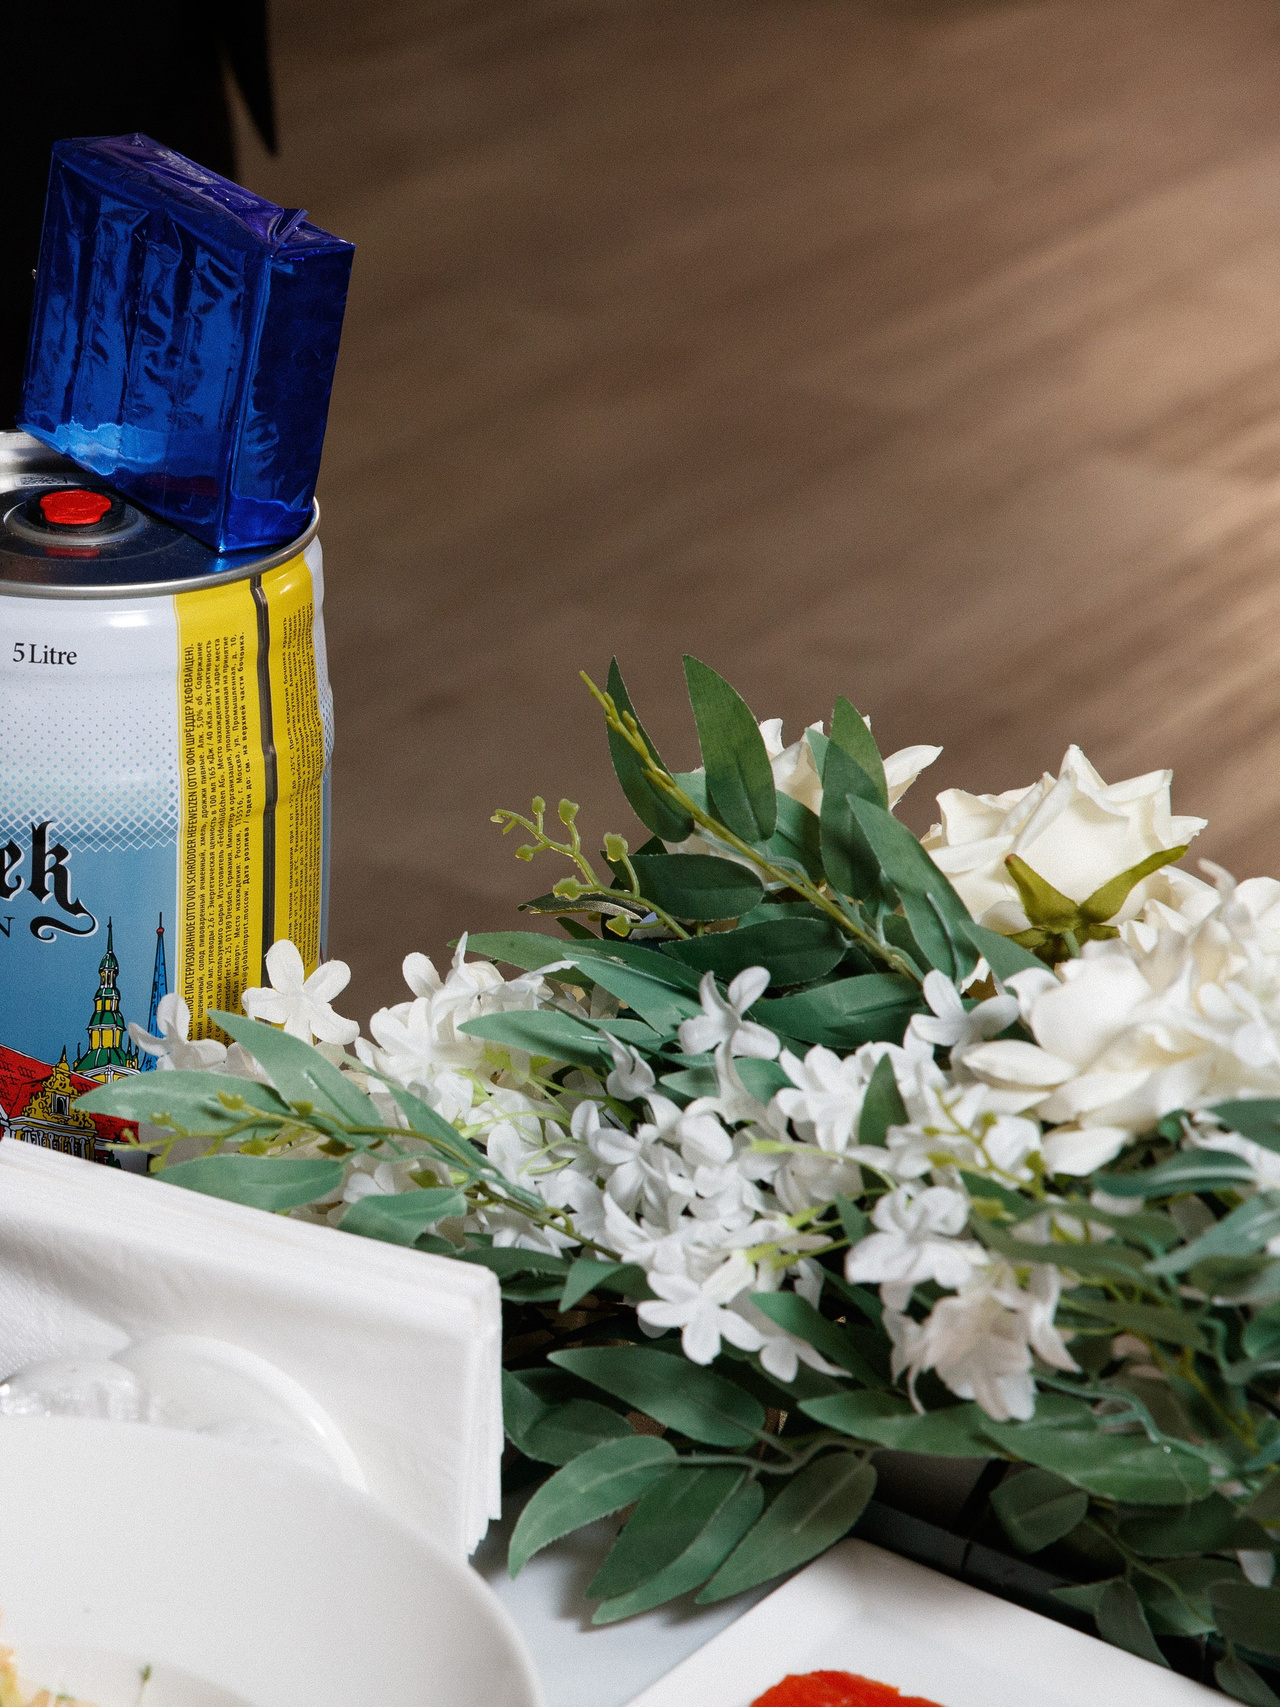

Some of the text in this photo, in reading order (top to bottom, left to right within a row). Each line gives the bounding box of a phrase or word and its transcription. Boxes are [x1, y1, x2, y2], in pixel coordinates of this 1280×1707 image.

[12, 642, 78, 665] 5 Litre
[195, 642, 204, 689] Содержание
[232, 651, 237, 659] д.
[184, 643, 195, 703] ХЕФЕВАЙЦЕН).
[223, 675, 228, 684] на
[231, 663, 240, 730] Промышленная,
[185, 705, 195, 745] ШРЁДДЕР
[206, 731, 213, 740] 40
[224, 686, 232, 751] уполномоченная
[186, 747, 195, 765] ФОН
[243, 745, 248, 754] на
[187, 767, 197, 789] (ОТТО
[211, 781, 216, 792] мл
[227, 754, 235, 804] организация,
[187, 791, 197, 837] HEFEWEIZEN
[217, 790, 226, 846] «Feldschlößchen
[235, 797, 244, 826] 115516,
[226, 813, 235, 848] Импортер
[185, 838, 196, 882] SCHRÖDDER
[226, 850, 234, 887] Германия.
[187, 884, 196, 900] VON
[208, 851, 216, 908] Энергетическая
[186, 902, 195, 920] OTTO
[185, 921, 195, 994] ПАСТЕРИЗОВАННОЕ
[233, 941, 241, 976] Импорт».
